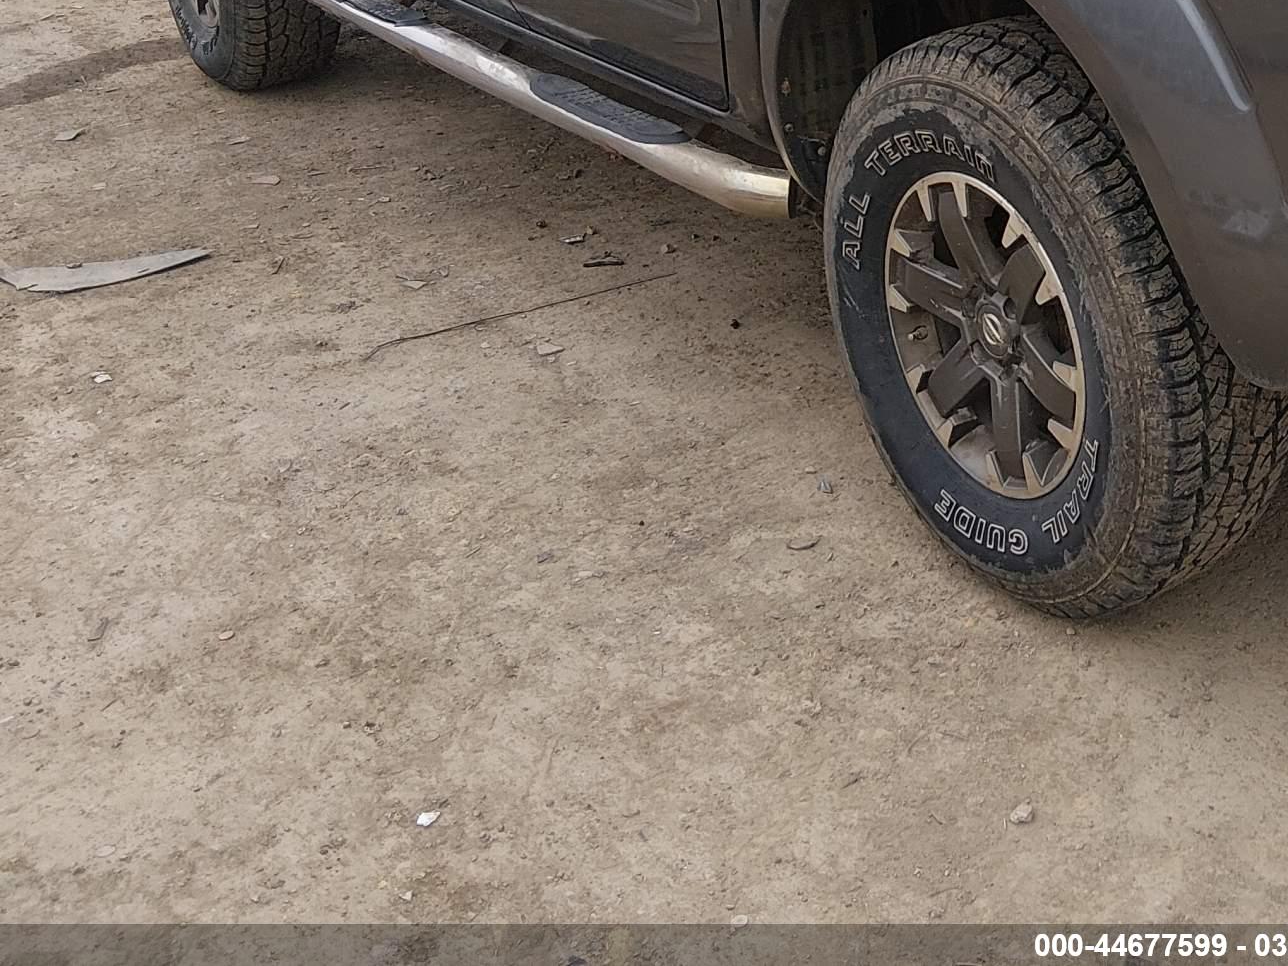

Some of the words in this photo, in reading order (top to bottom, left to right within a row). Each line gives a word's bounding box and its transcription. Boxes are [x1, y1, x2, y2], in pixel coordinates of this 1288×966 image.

[842, 190, 872, 271] ALL
[864, 129, 996, 184] TERRAIN
[934, 489, 1029, 556] GUIDE
[1041, 439, 1100, 544] TRAIL
